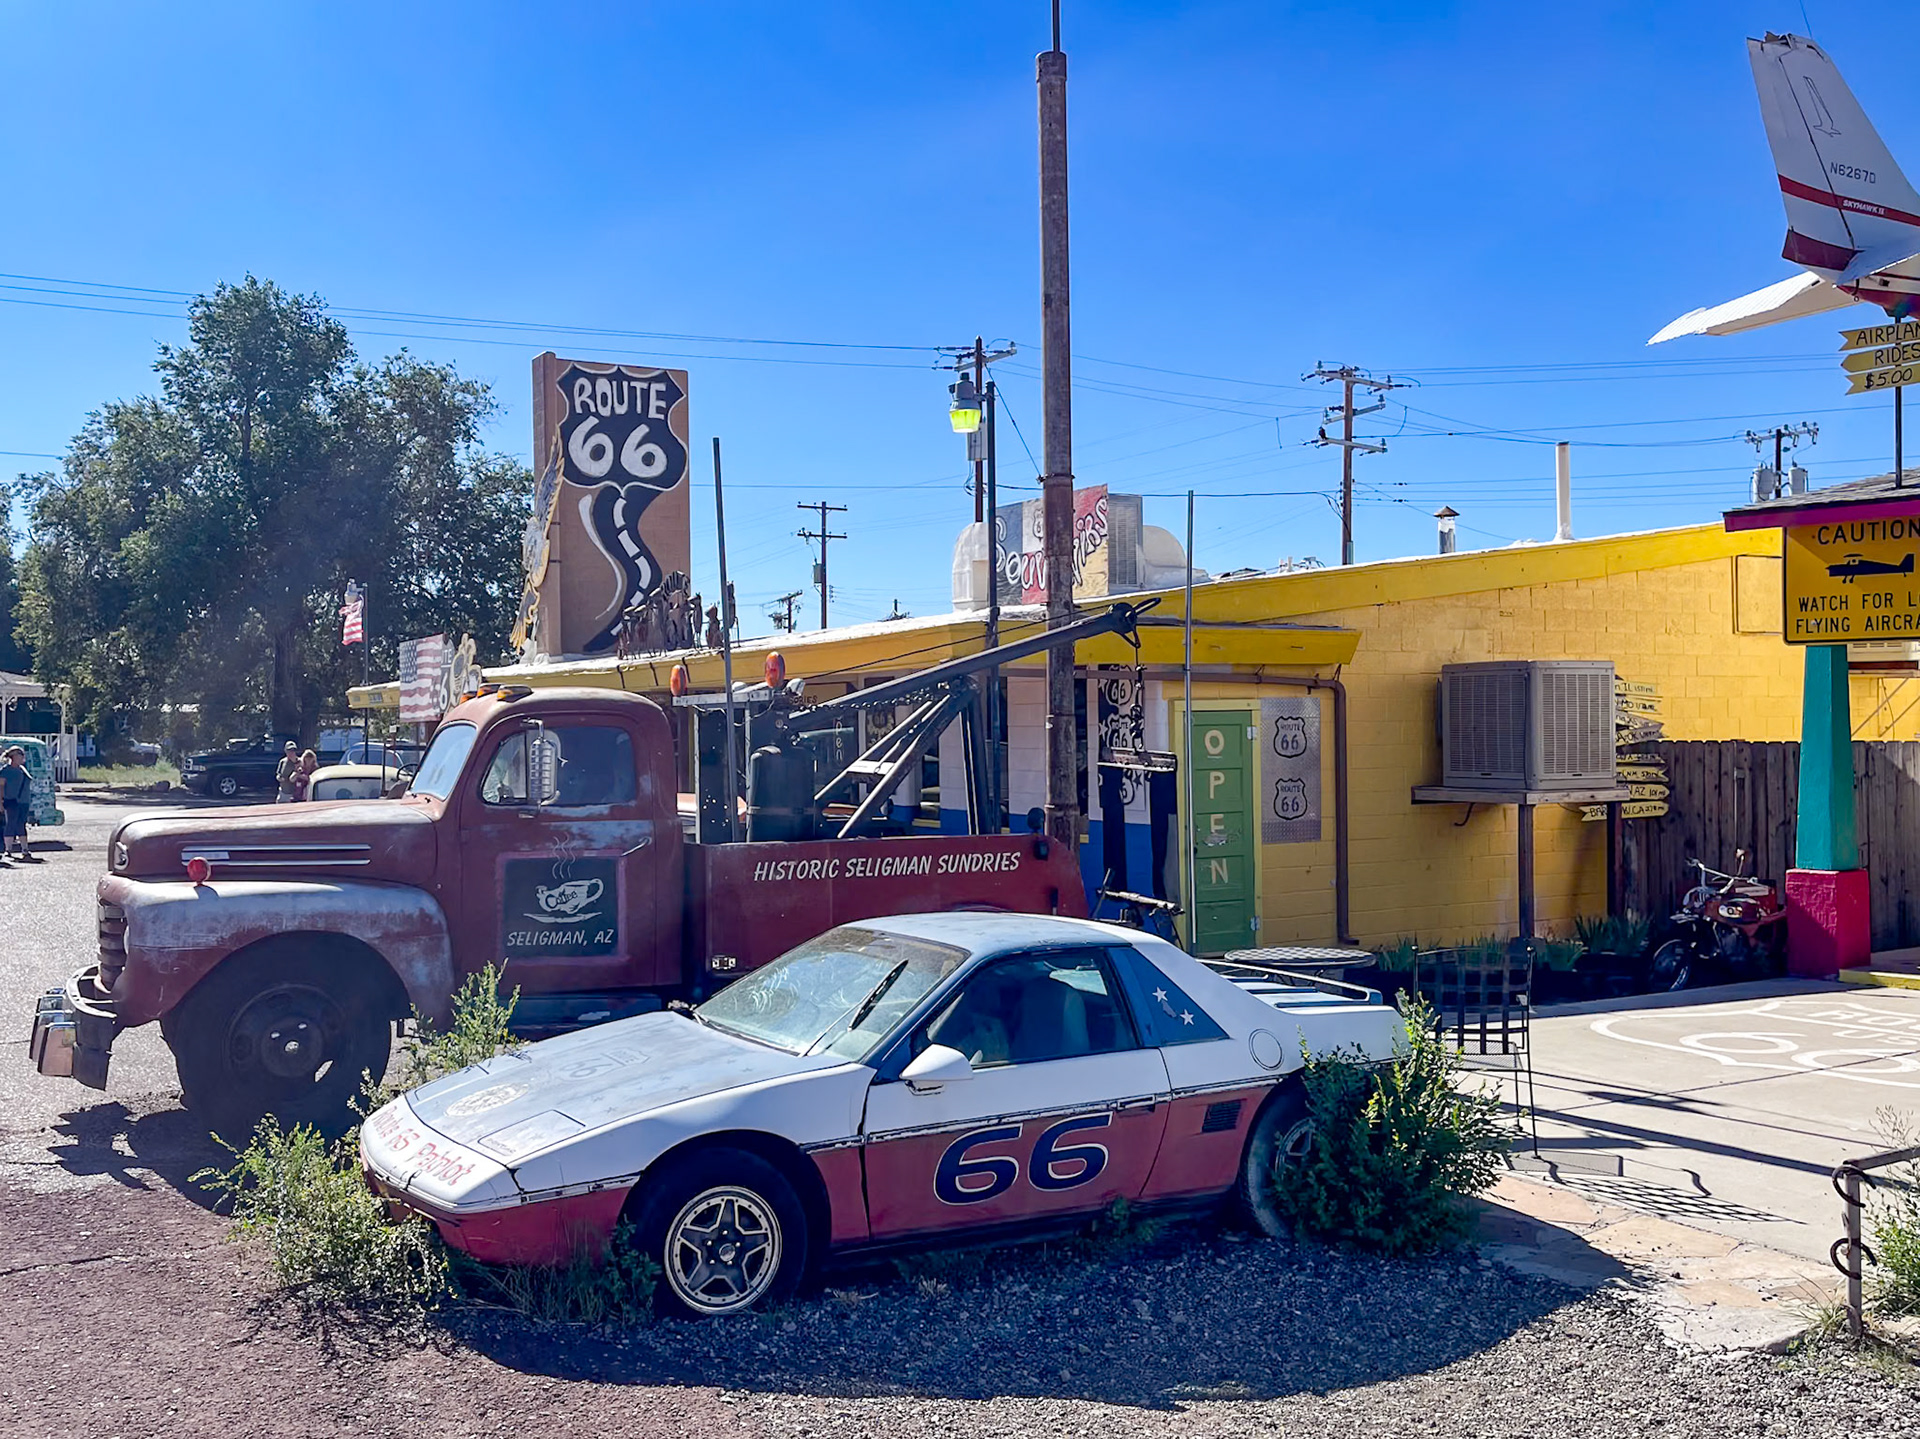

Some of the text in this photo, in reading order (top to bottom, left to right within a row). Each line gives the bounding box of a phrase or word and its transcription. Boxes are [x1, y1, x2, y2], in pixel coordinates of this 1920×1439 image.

[1830, 162, 1876, 184] N6267D
[1843, 199, 1878, 214] SKYHAWK
[1874, 343, 1920, 366] RIDES
[1864, 368, 1913, 389] $5.00
[574, 377, 667, 420] ROUTE
[568, 415, 668, 478] 66
[1817, 519, 1920, 545] CAUTION
[1798, 594, 1849, 613] WATCH
[1862, 592, 1894, 610] FOR
[1796, 616, 1850, 634] FLYING
[1112, 682, 1127, 698] 66
[1281, 723, 1300, 732] ROUTE
[1112, 732, 1128, 748] 66
[1280, 734, 1300, 751] 66
[1280, 785, 1300, 794] ROUTE
[1204, 728, 1229, 885] OPEN
[1281, 796, 1300, 812] 66
[754, 851, 1021, 882] HISTORIC SELIGMAN SUNDRIES
[545, 888, 578, 909] Coffee
[506, 929, 614, 947] SELIGMAN, AZ
[933, 1110, 1114, 1206] 66
